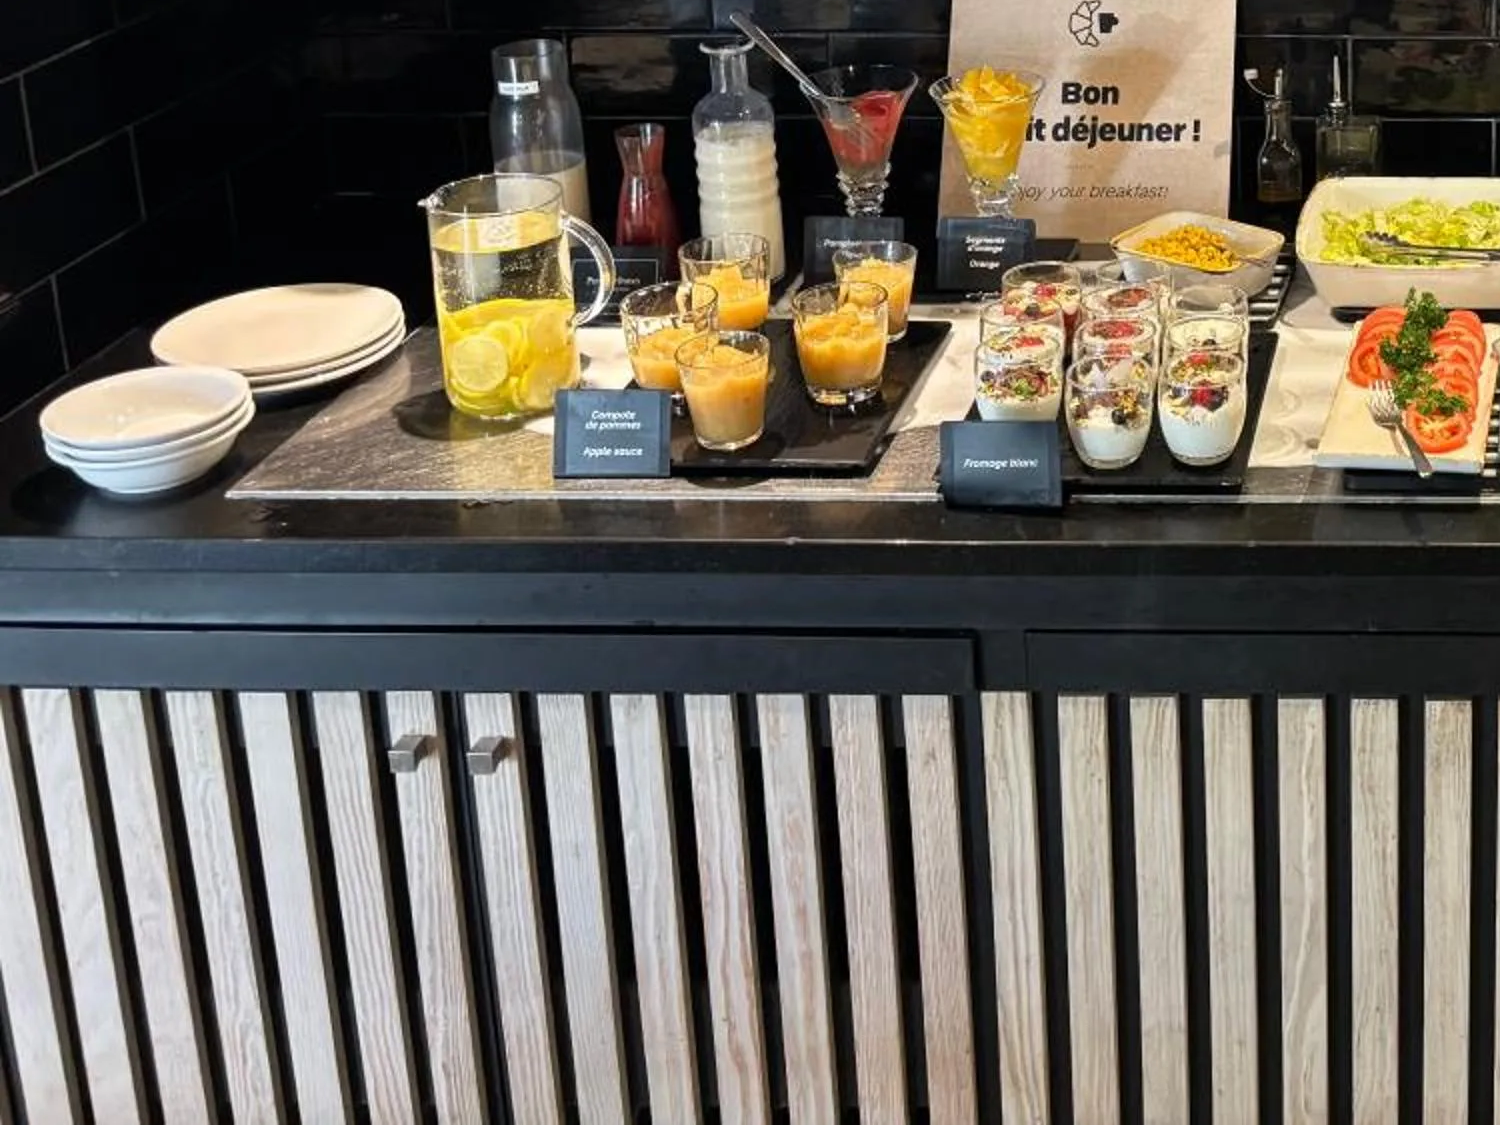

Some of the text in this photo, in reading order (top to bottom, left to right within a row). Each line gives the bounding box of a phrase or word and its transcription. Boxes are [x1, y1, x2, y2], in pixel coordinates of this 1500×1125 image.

[1061, 81, 1120, 105] Bon
[1051, 114, 1187, 150] déjeuner
[1192, 118, 1201, 142] !
[1046, 186, 1087, 201] your
[1089, 183, 1170, 200] breakfast!
[969, 258, 1000, 270] Orange
[591, 410, 637, 421] Compote
[583, 446, 643, 457] Apple sauce
[963, 458, 1009, 470] Fromage
